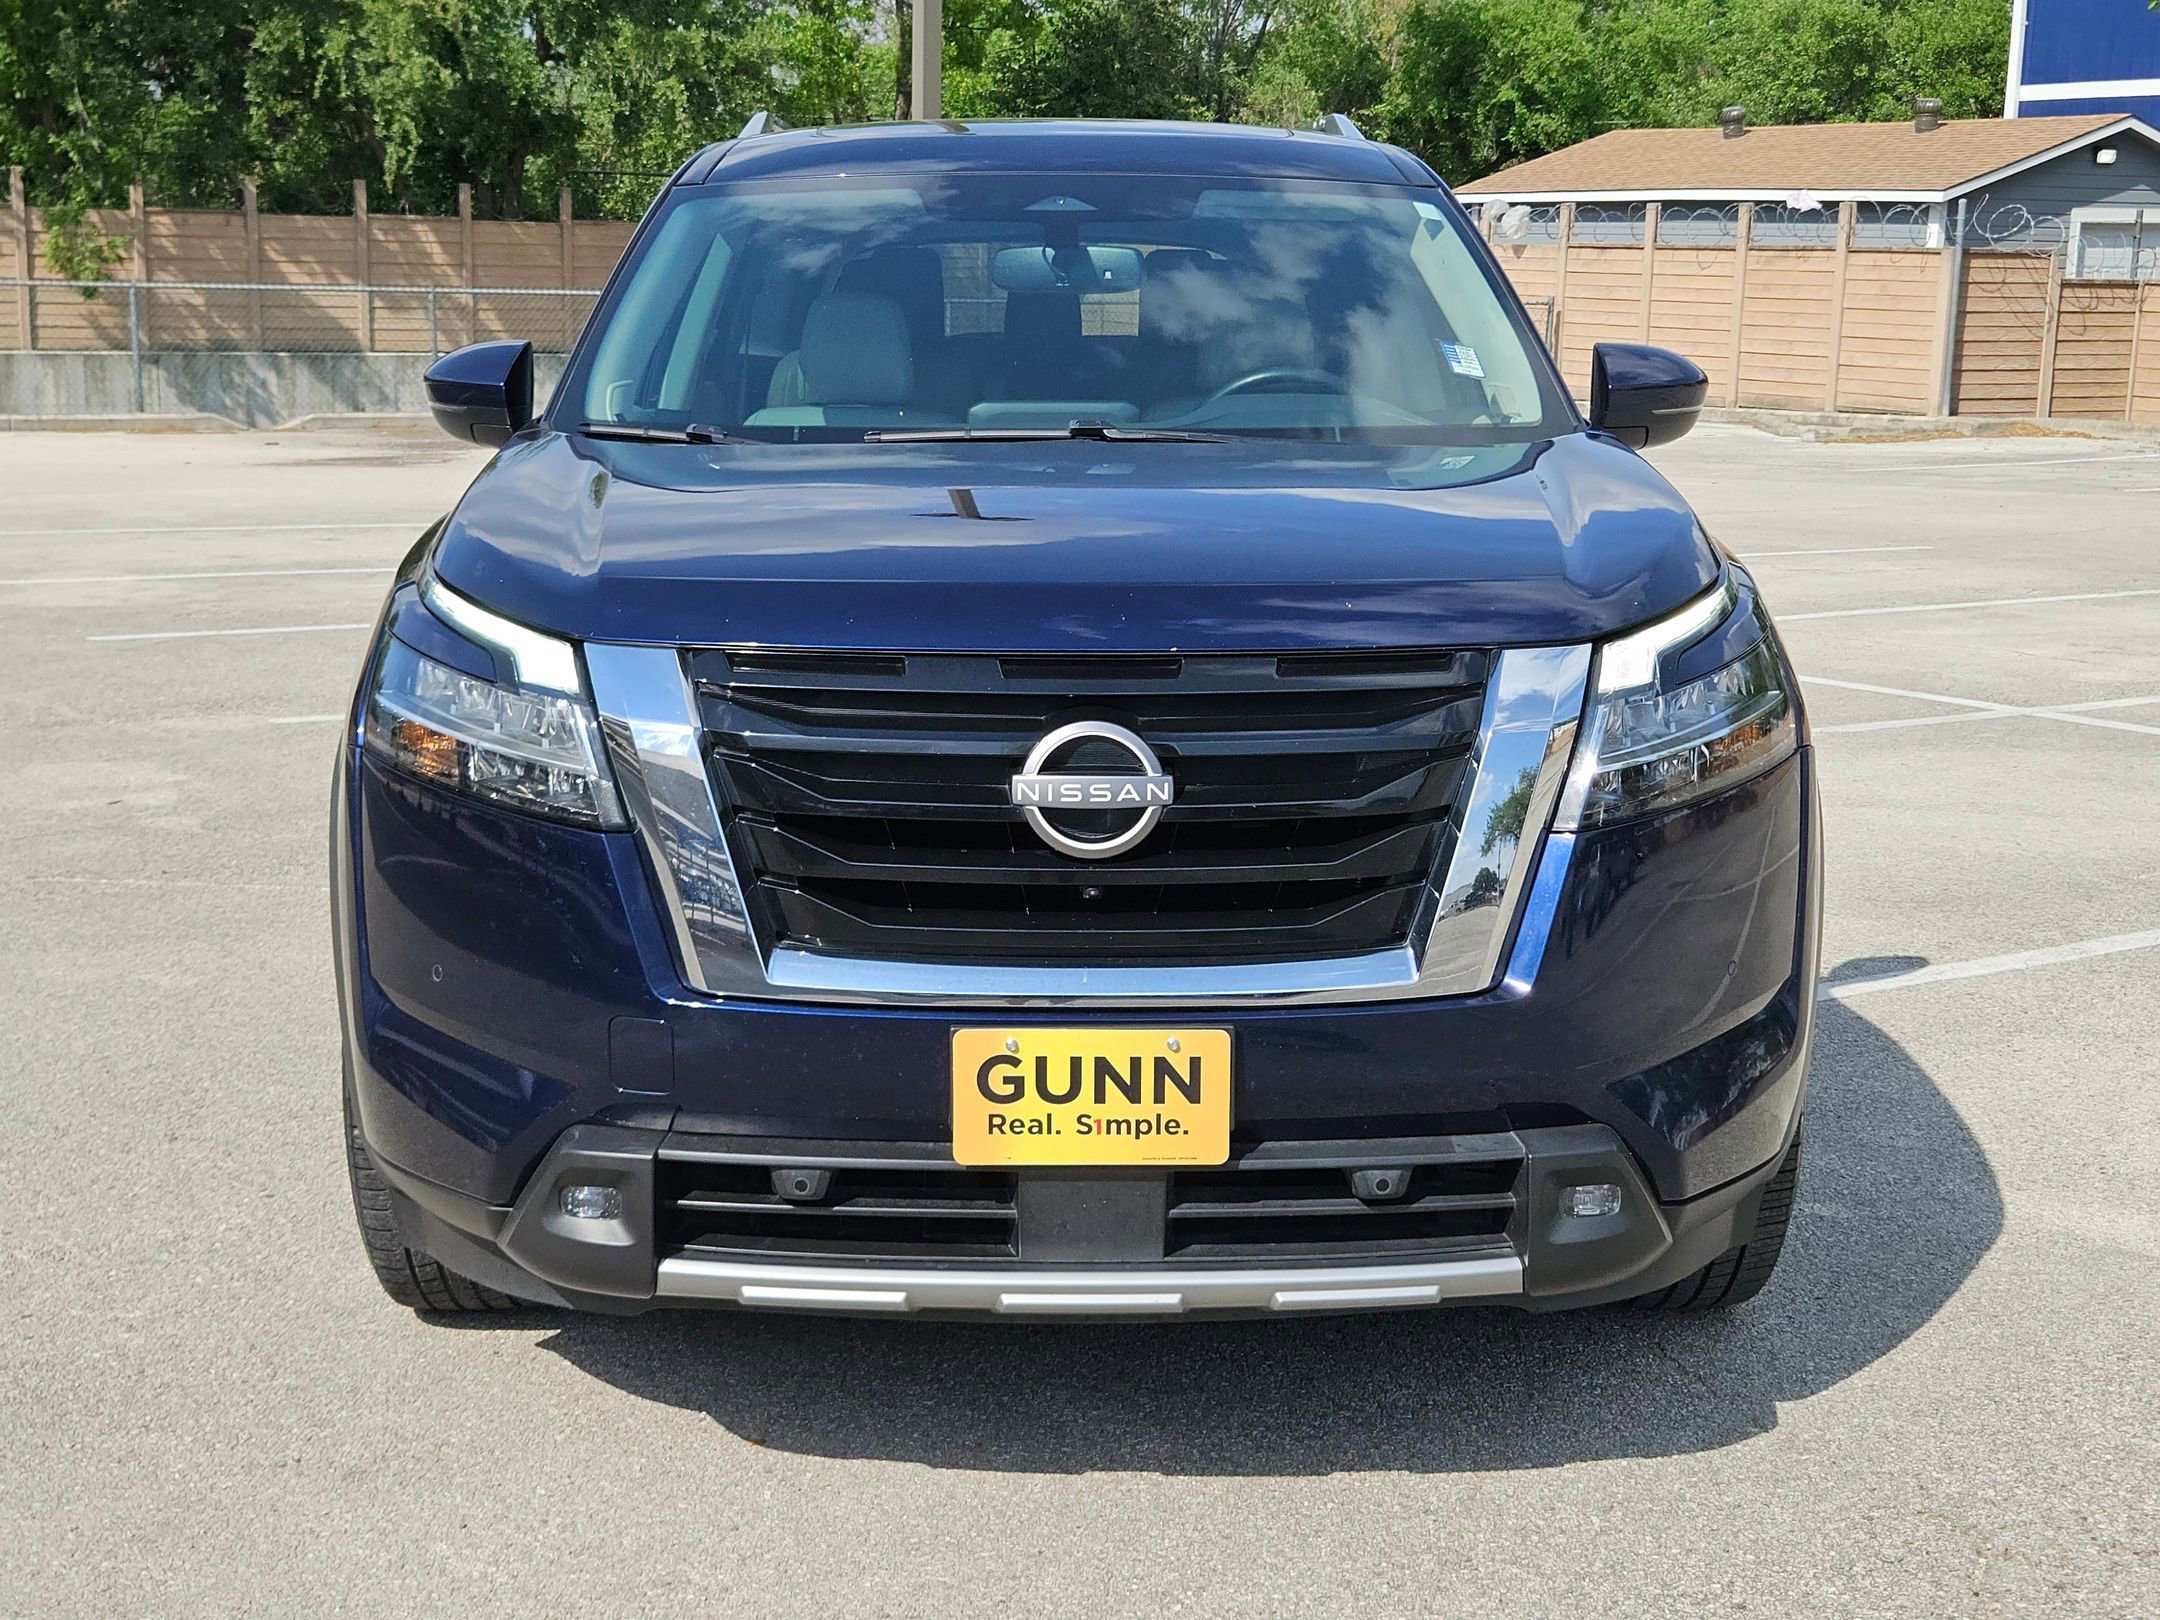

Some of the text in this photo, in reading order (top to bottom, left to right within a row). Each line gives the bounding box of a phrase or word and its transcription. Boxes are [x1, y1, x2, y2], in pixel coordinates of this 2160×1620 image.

[1016, 782, 1169, 802] NISSAN
[976, 1054, 1202, 1105] GUNN
[988, 1113, 1062, 1135] Real.
